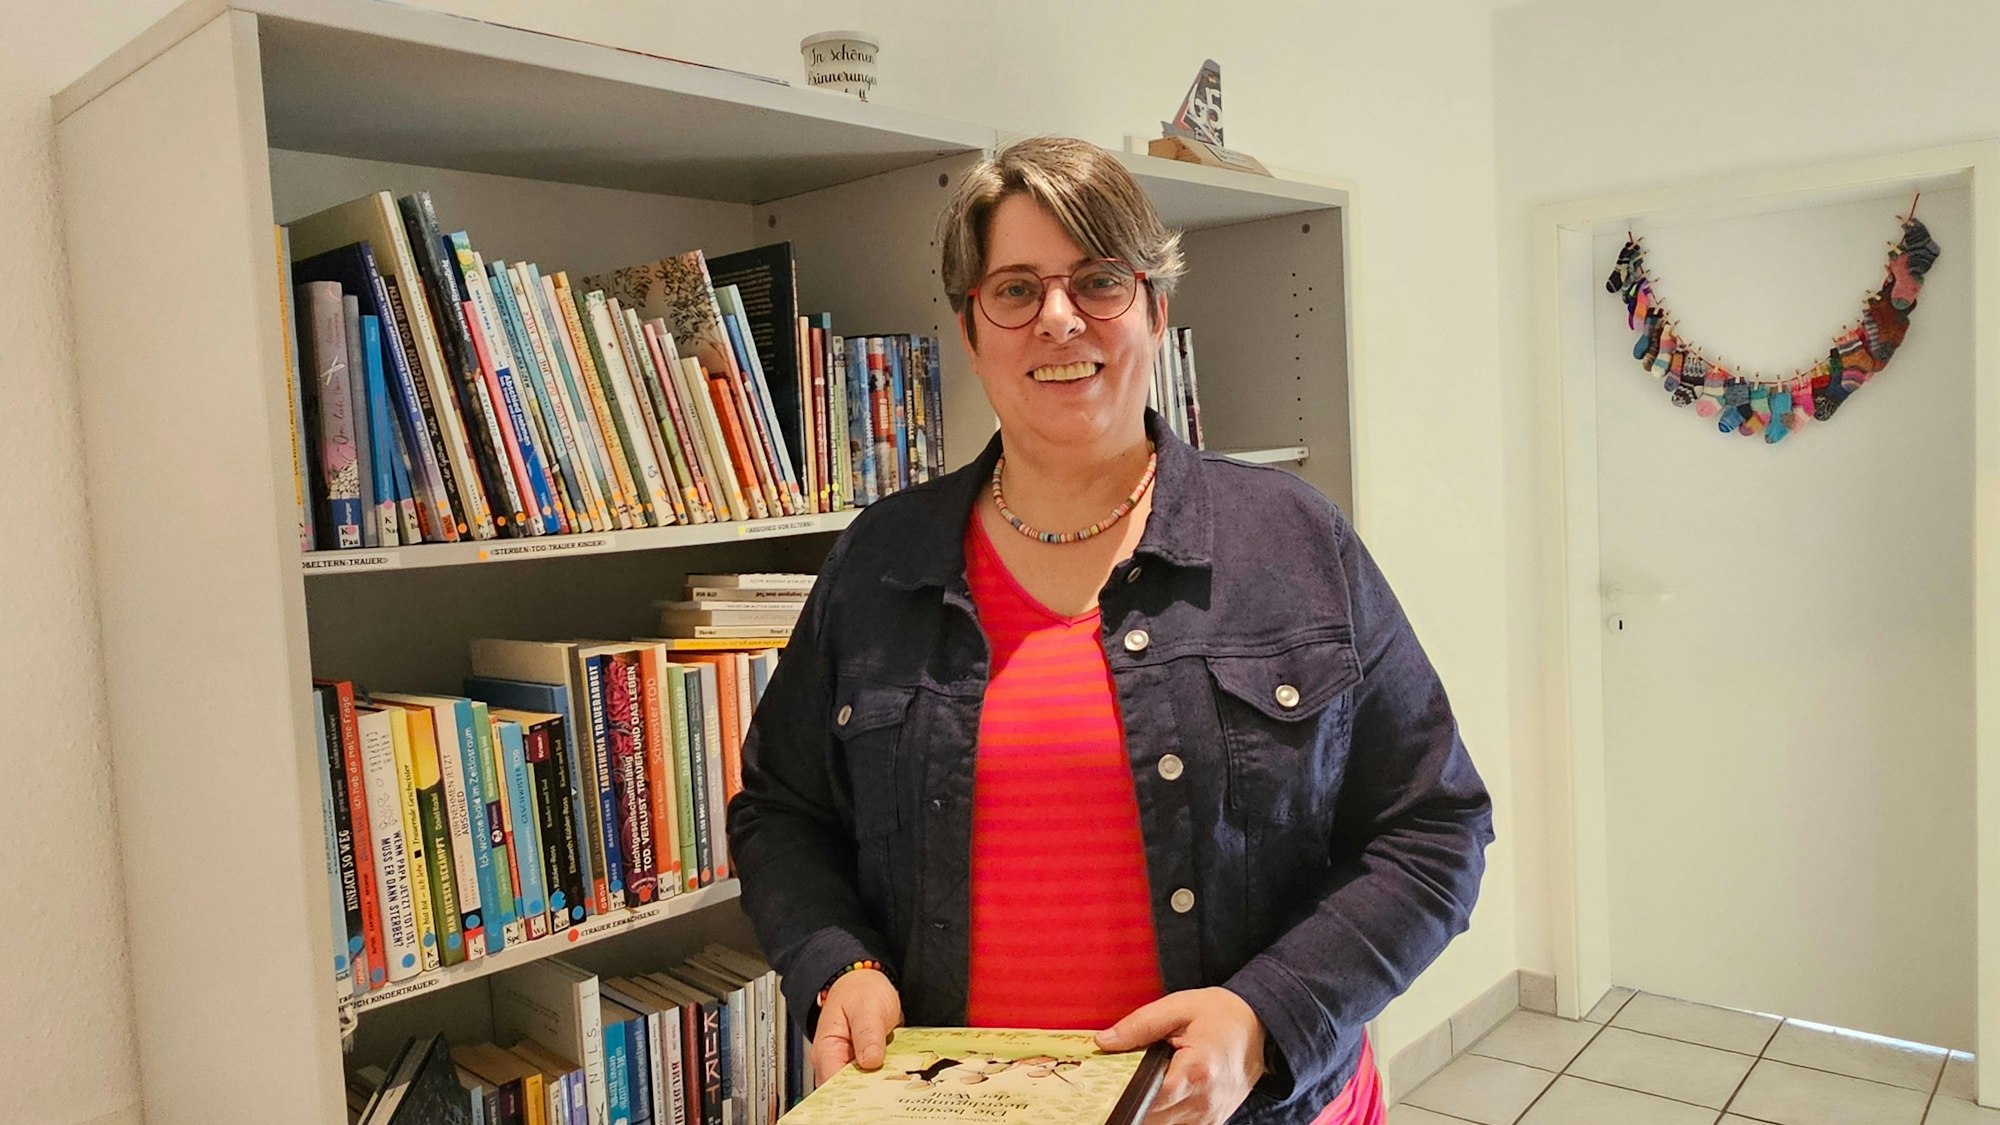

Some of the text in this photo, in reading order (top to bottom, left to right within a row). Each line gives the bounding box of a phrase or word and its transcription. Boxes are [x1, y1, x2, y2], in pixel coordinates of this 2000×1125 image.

[809, 47, 823, 67] In
[386, 284, 436, 410] RADIESCHEN VON UNTEN
[502, 373, 523, 412] Abschied
[515, 412, 534, 446] nehmen
[904, 389, 916, 440] RATATOUILLE
[588, 665, 605, 736] TRAUERARBEIT
[626, 665, 638, 702] LEBEN
[630, 702, 640, 725] DAS
[645, 677, 664, 765] Schwester TOD
[632, 725, 643, 750] UND
[596, 736, 611, 793] TABUTHEMA
[634, 751, 646, 794] TRAUER
[442, 753, 462, 838] WIR NEHMEN JETZT
[456, 790, 470, 836] ABSCHIED
[463, 727, 490, 868] Ich wohne bald im Zeitlosraum
[623, 755, 644, 873] #nichtgesellschaftsfähig
[339, 828, 352, 852] WEG
[560, 796, 573, 840] Kübler-Ross
[342, 854, 354, 868] SO
[402, 763, 430, 925] bist tot ich lebe Trauernde Geschwister
[434, 836, 451, 881] BEKÄMPFT
[565, 840, 578, 874] Elisabeth
[547, 845, 561, 889] Kübler-Ross
[342, 869, 360, 911] EINFACH
[380, 837, 404, 948] MUSS ER DANN STERBEN?
[392, 831, 415, 948] WENN PAPA JETZT TOT IST,
[441, 881, 455, 915] RIESEN
[599, 883, 608, 909] GROH
[446, 915, 457, 933] MAN
[586, 1027, 601, 1084] NILS
[699, 1010, 725, 1105] KURT
[895, 1097, 1031, 1112] Beerdigungen
[904, 1106, 1008, 1119] Die besten
[927, 1091, 1011, 1102] der Welt
